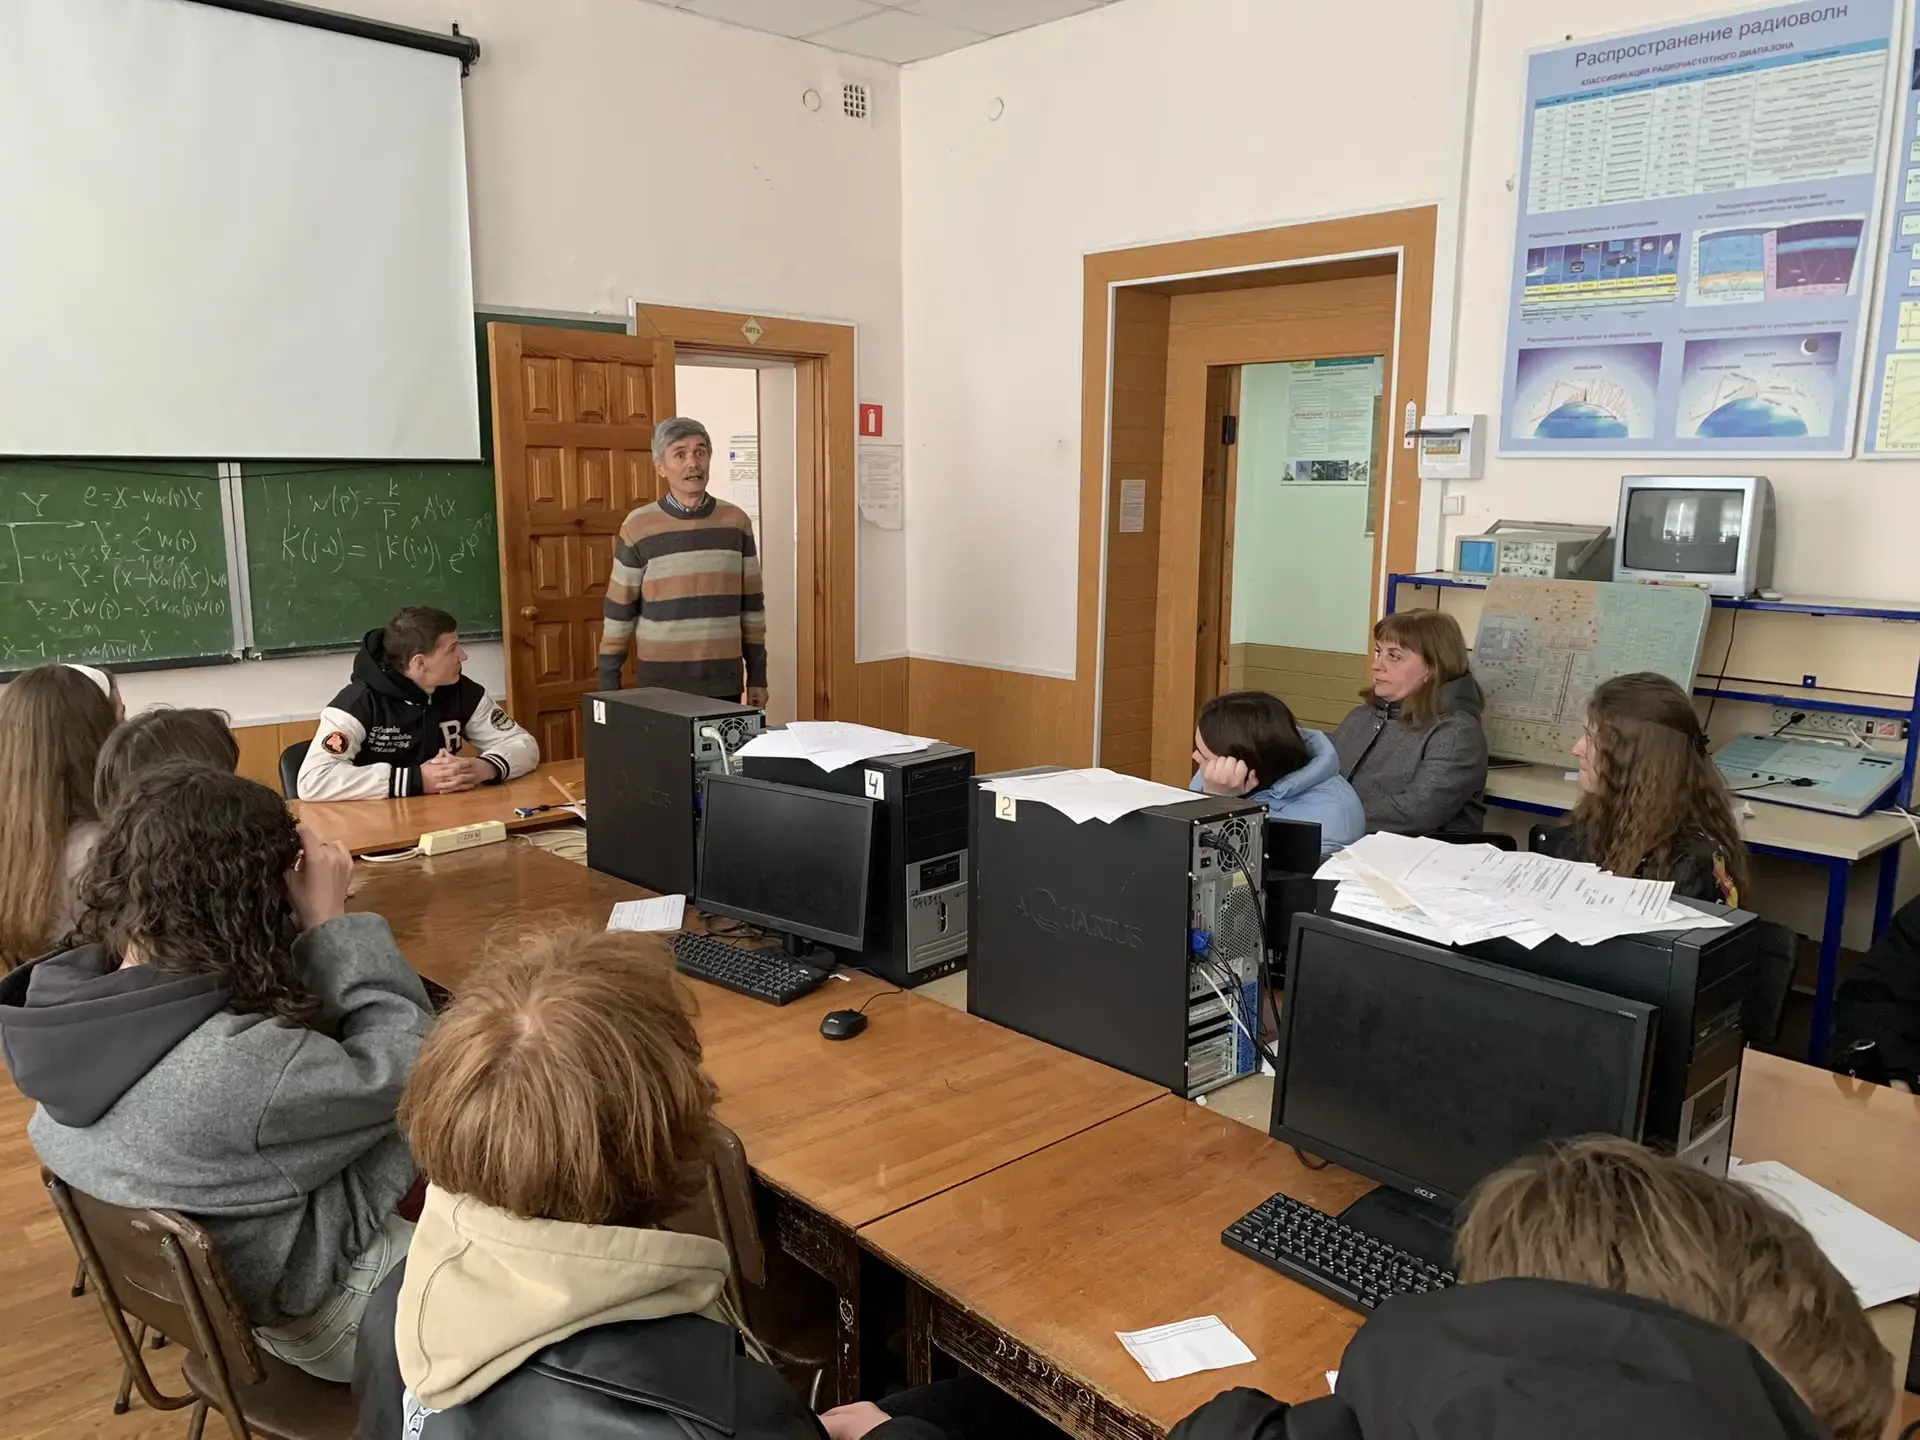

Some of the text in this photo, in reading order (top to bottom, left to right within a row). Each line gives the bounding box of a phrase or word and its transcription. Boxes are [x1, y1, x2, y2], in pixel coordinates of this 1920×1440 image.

[1575, 4, 1848, 68] Распространение радиоволн
[1581, 41, 1795, 87] КЛАССИФИКАЦИЯ РАДИОЧАСТОТНОГО ДИАПАЗОНА
[438, 719, 463, 753] R
[869, 772, 879, 796] 4
[1002, 796, 1012, 816] 2
[1414, 1186, 1437, 1200] acer
